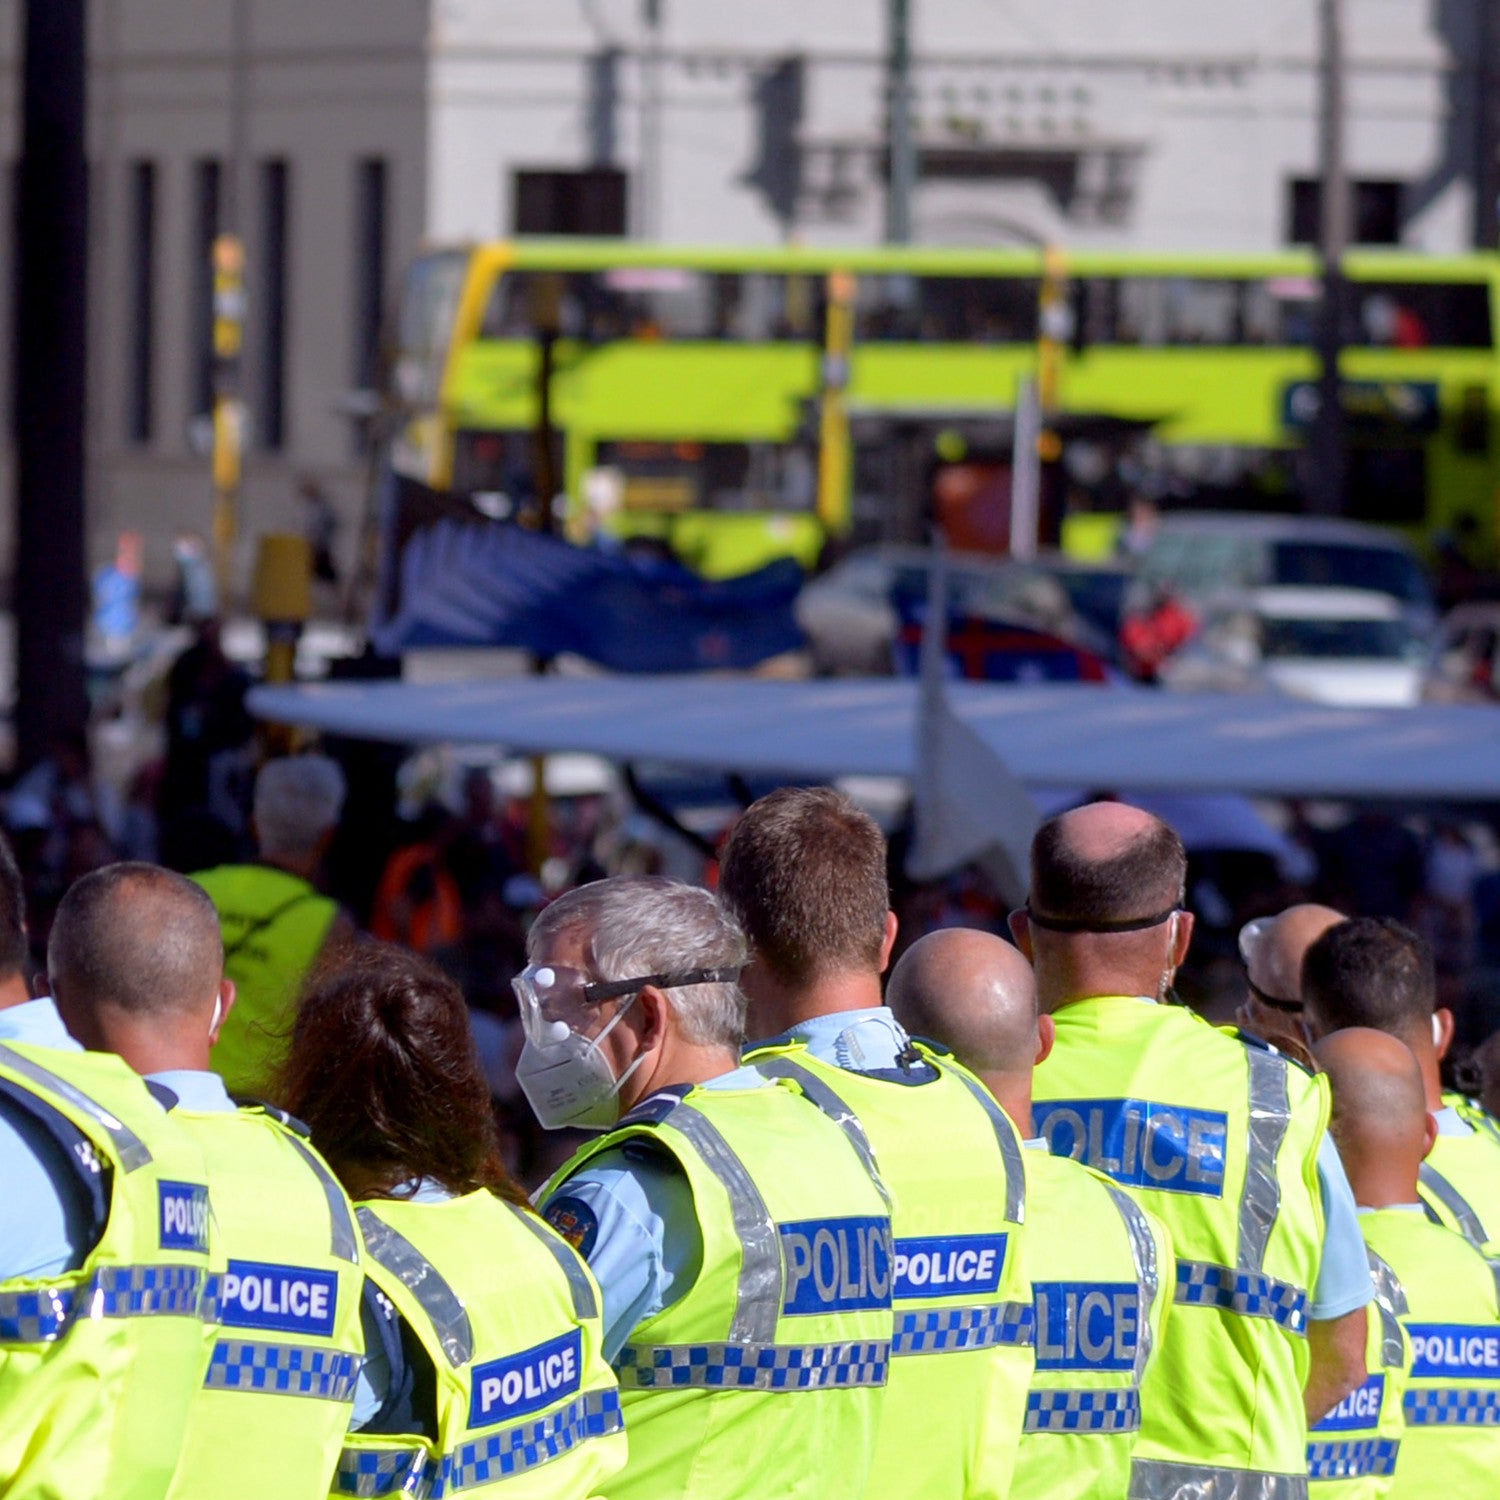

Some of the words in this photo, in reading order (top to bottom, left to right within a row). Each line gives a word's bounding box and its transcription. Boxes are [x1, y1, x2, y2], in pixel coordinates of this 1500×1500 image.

[1031, 1108, 1226, 1185] OLICE
[221, 1273, 330, 1320] POLICE
[783, 1226, 892, 1304] POLIC
[893, 1249, 997, 1286] POLICE
[481, 1347, 576, 1413] POLICE
[1412, 1335, 1500, 1367] POLICE
